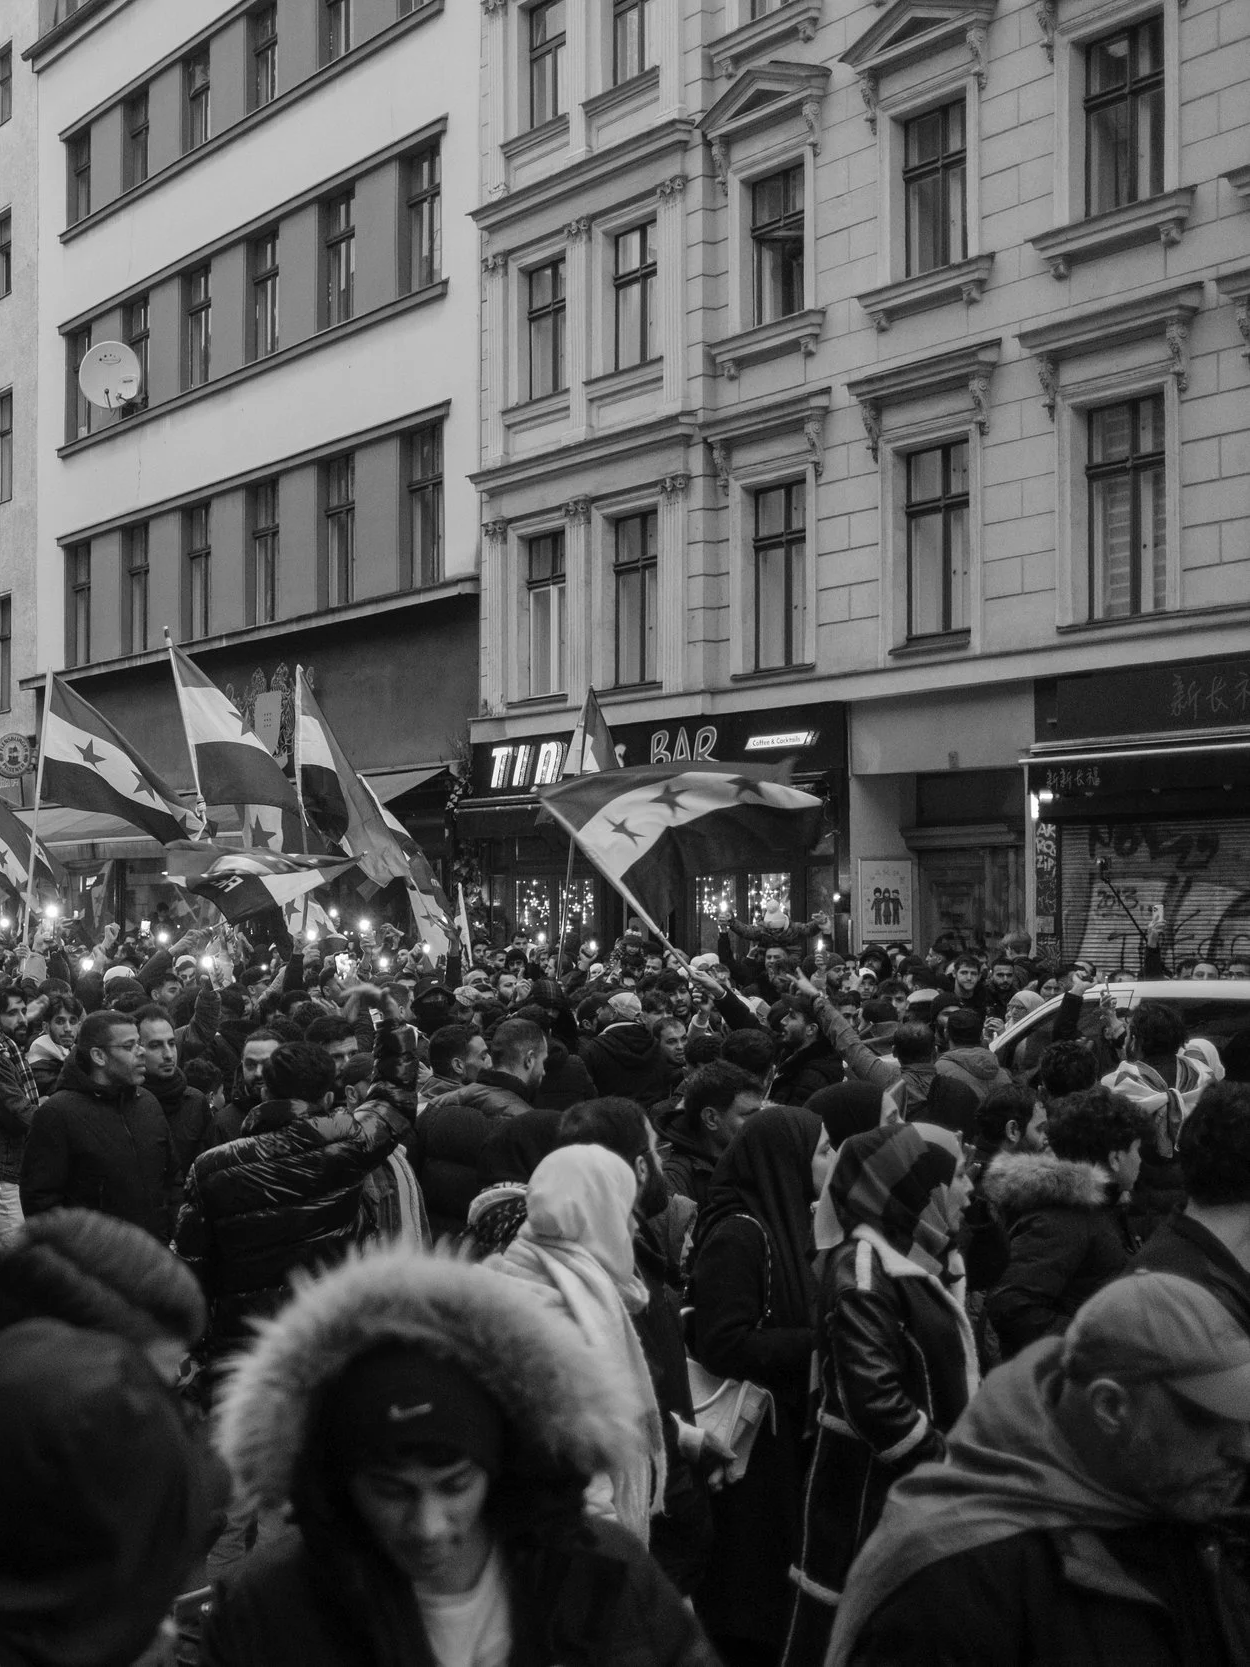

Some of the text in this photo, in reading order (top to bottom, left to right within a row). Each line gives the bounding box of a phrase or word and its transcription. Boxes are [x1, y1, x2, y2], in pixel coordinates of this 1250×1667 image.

[651, 727, 719, 764] BAR
[752, 739, 770, 747] Coffee
[776, 735, 801, 745] Cocktails
